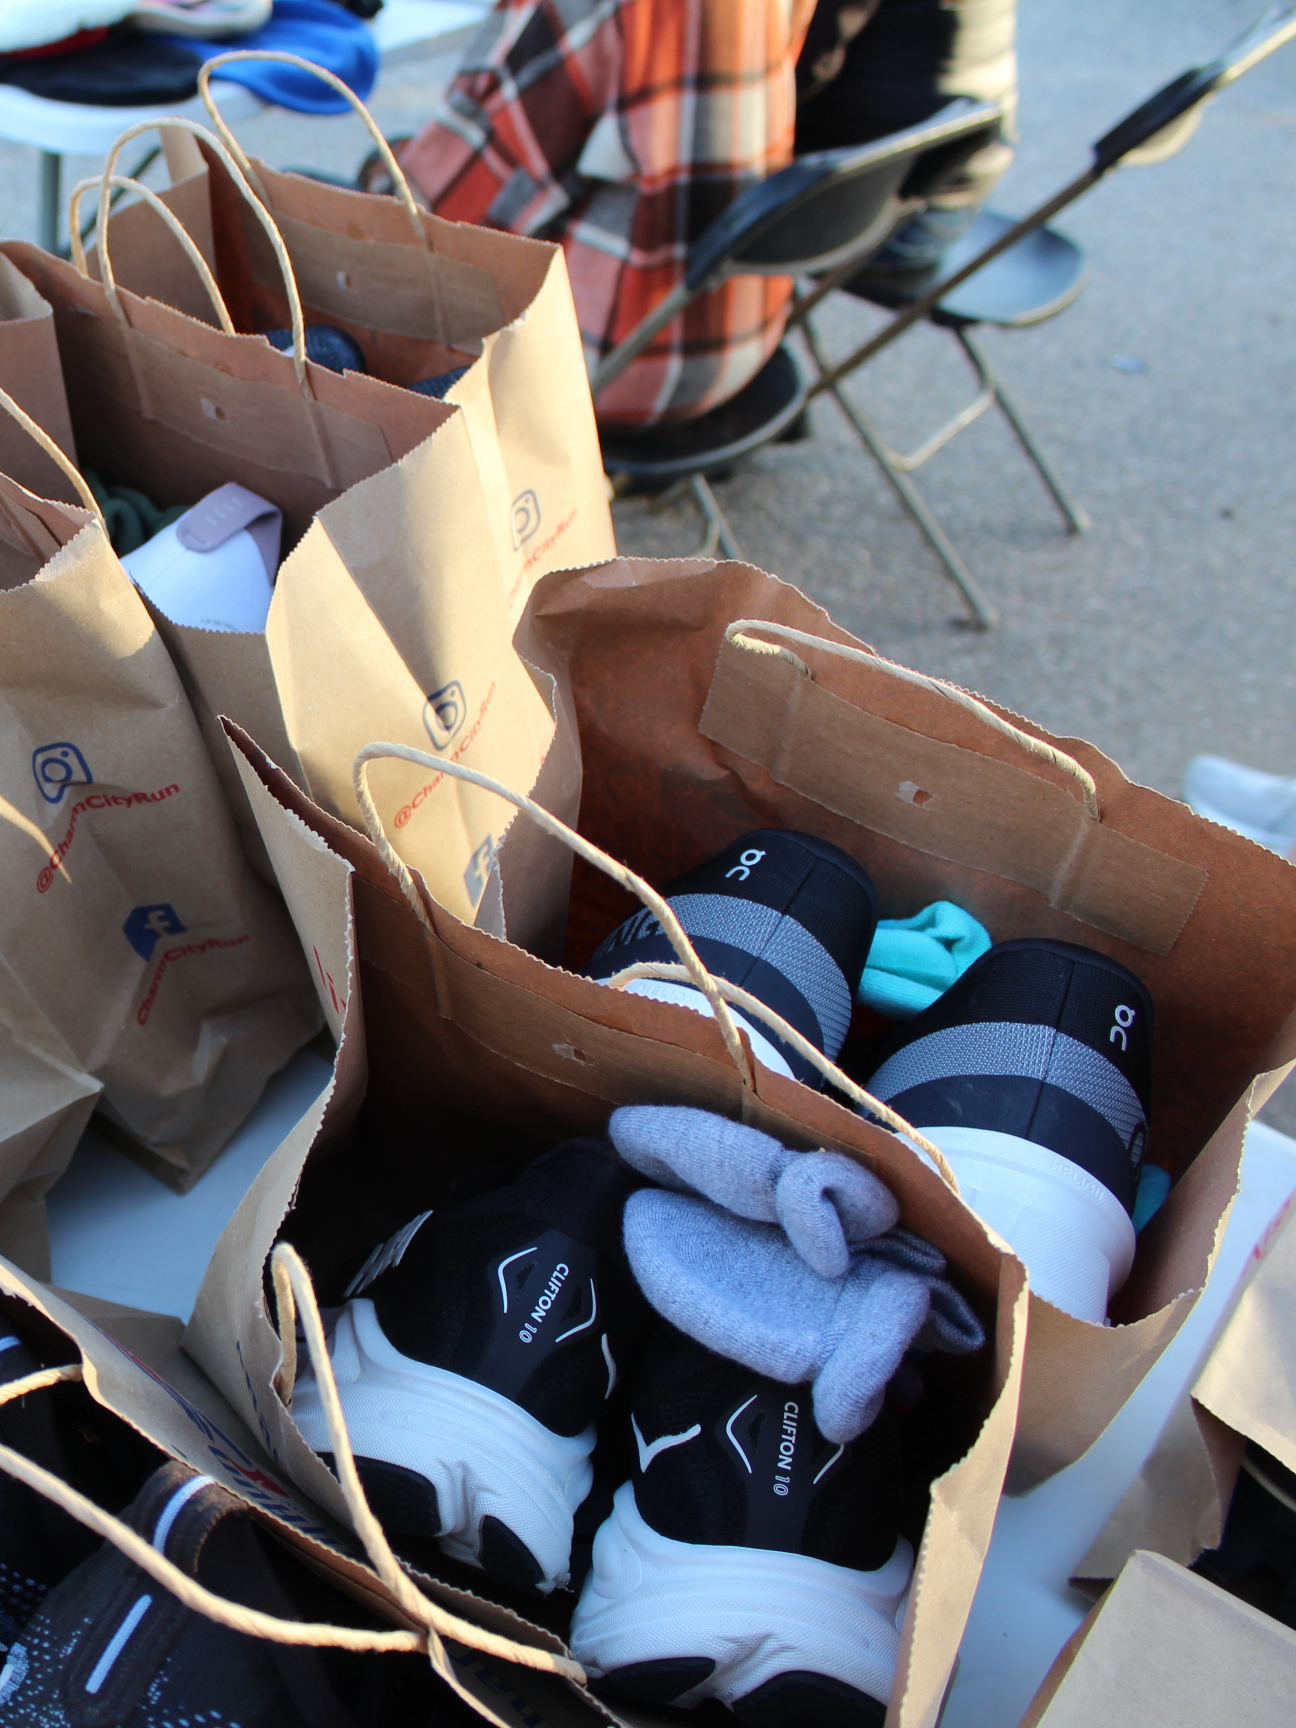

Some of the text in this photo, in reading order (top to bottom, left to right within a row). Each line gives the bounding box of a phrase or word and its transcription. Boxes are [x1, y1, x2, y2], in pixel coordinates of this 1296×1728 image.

[36, 783, 181, 894] @CharmCityRun
[137, 934, 250, 1026] CharmCityRun
[1050, 1160, 1104, 1200] HELION
[518, 1263, 570, 1343] CLIFTON 10
[773, 1401, 799, 1496] CLIFTON 10
